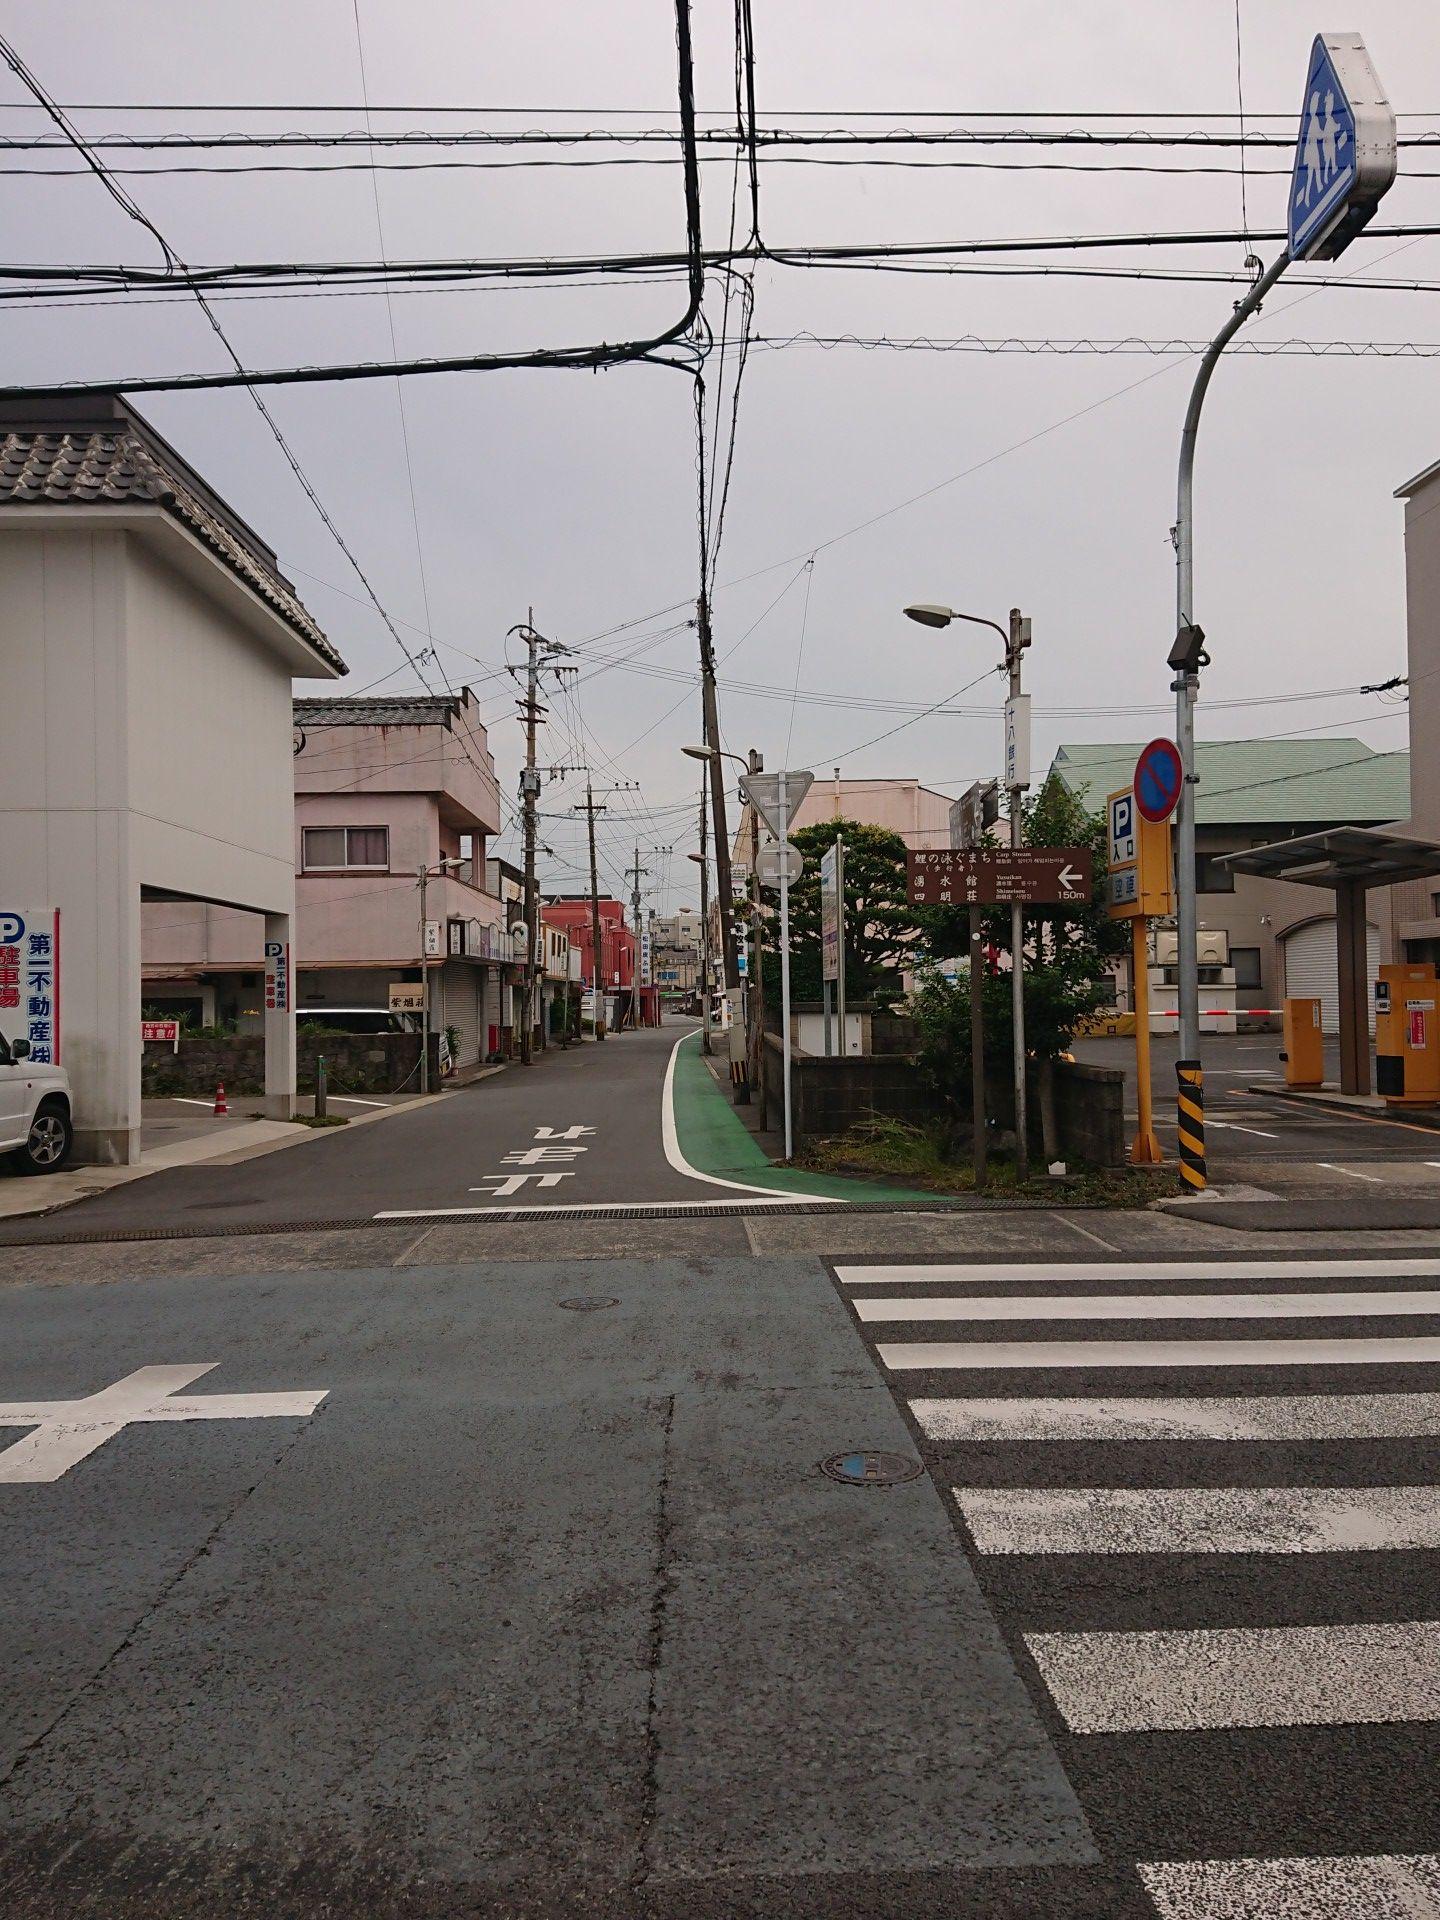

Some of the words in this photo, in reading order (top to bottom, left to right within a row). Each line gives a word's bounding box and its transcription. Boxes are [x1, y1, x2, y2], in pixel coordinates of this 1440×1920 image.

[1115, 800, 1130, 836] P
[1113, 839, 1134, 862] 入口
[914, 852, 991, 864] 鯉の泳ぐまち
[914, 875, 978, 887] 湧水館
[914, 890, 978, 902] 四明荘
[1057, 891, 1085, 899] 150m
[468, 1125, 599, 1196] 止まれ
